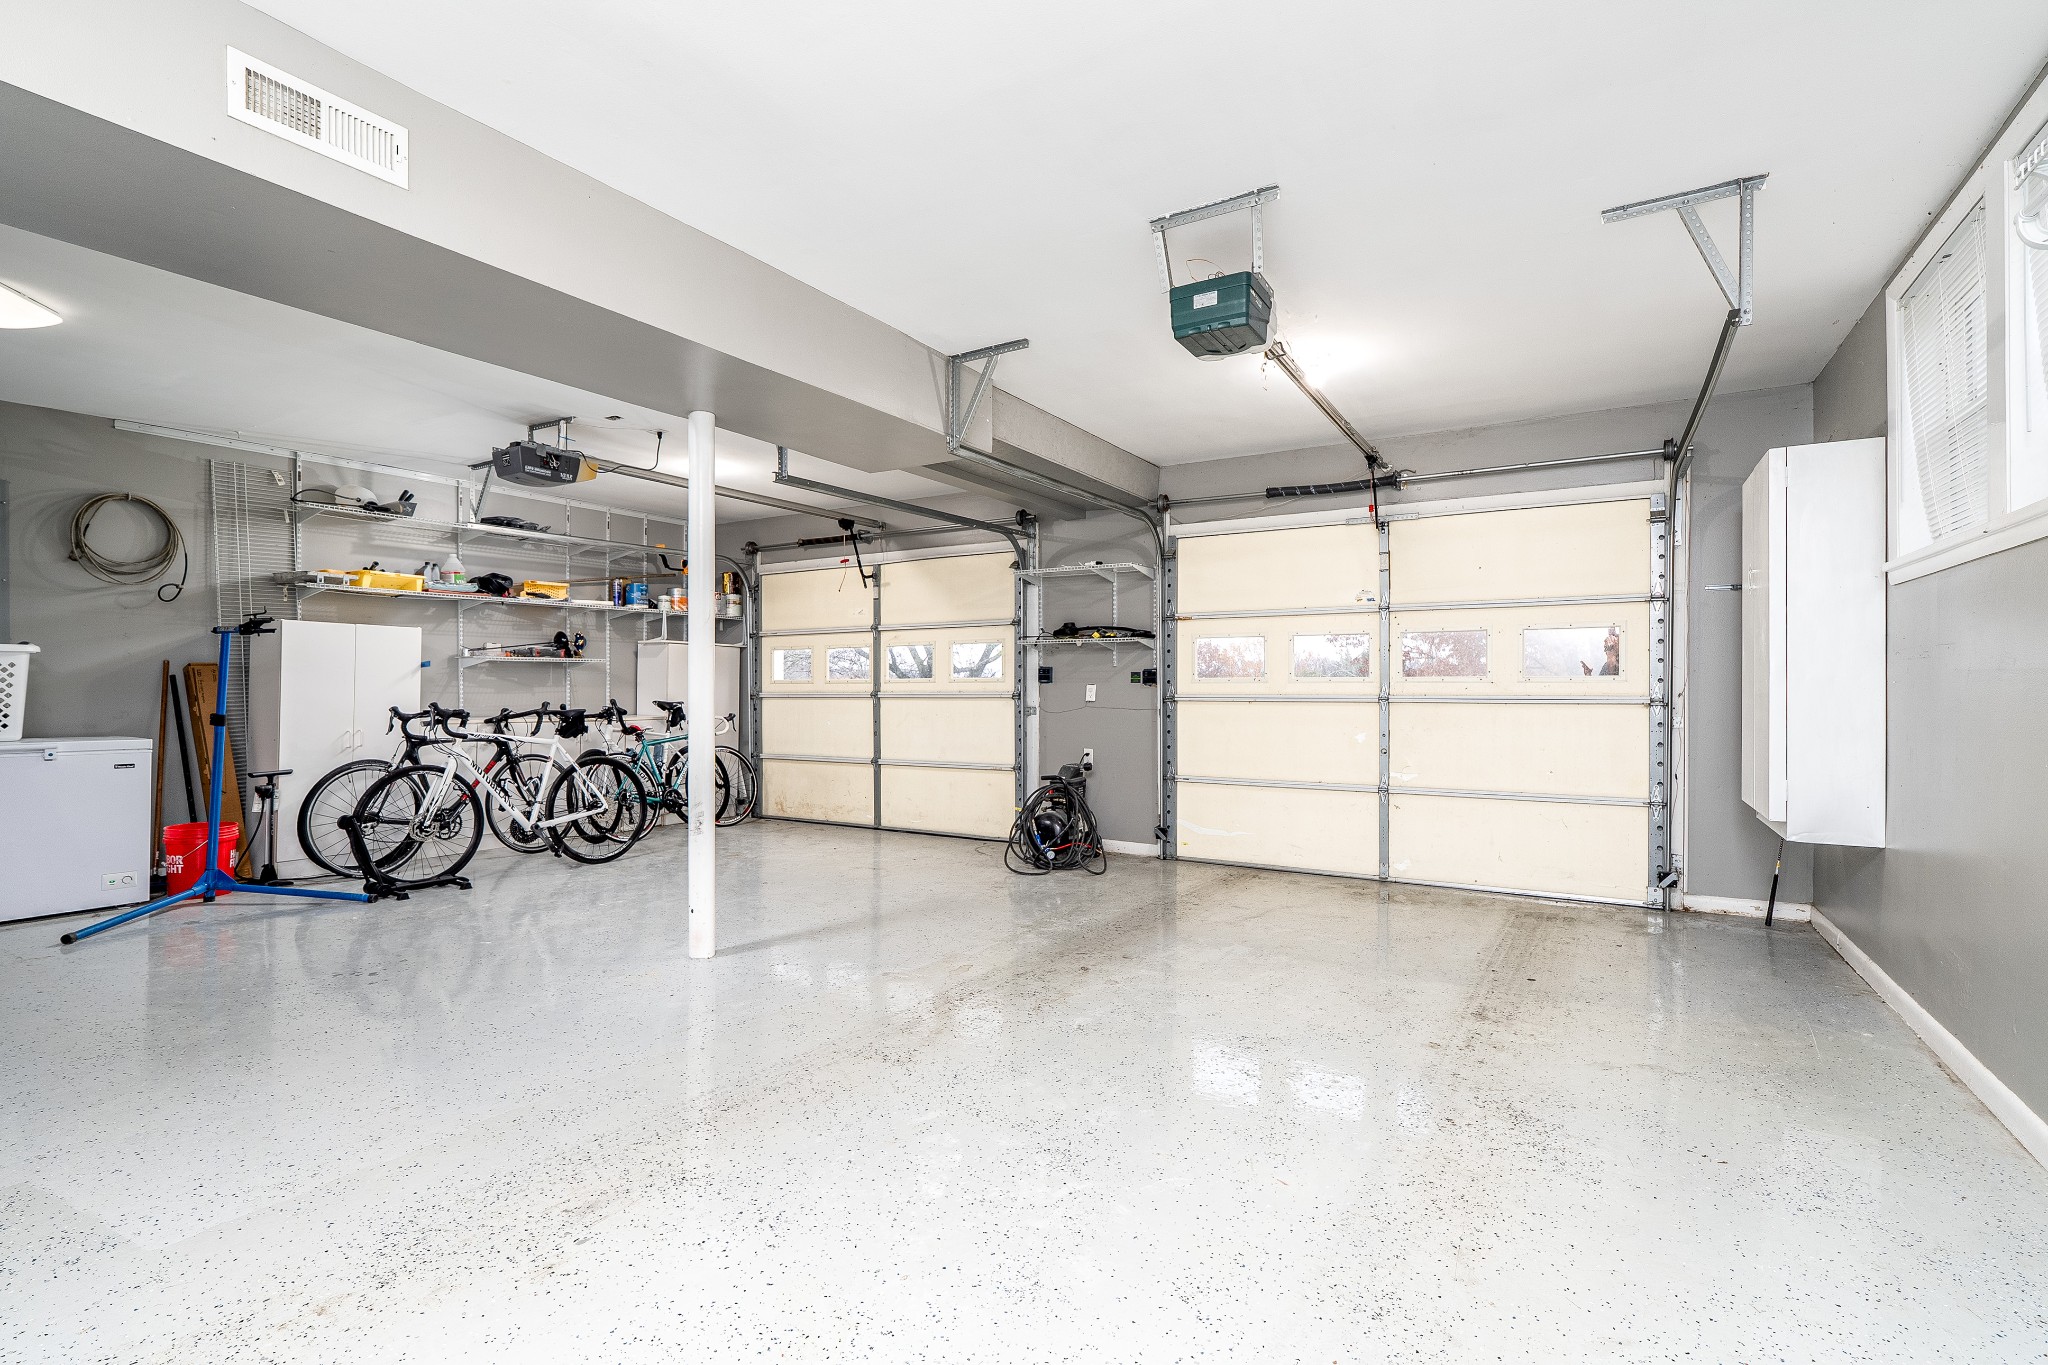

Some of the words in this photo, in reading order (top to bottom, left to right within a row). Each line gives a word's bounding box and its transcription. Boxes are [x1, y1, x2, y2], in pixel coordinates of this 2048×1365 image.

[471, 760, 515, 811] MOTOBECANE
[166, 855, 183, 864] BOR
[166, 864, 184, 873] GHT
